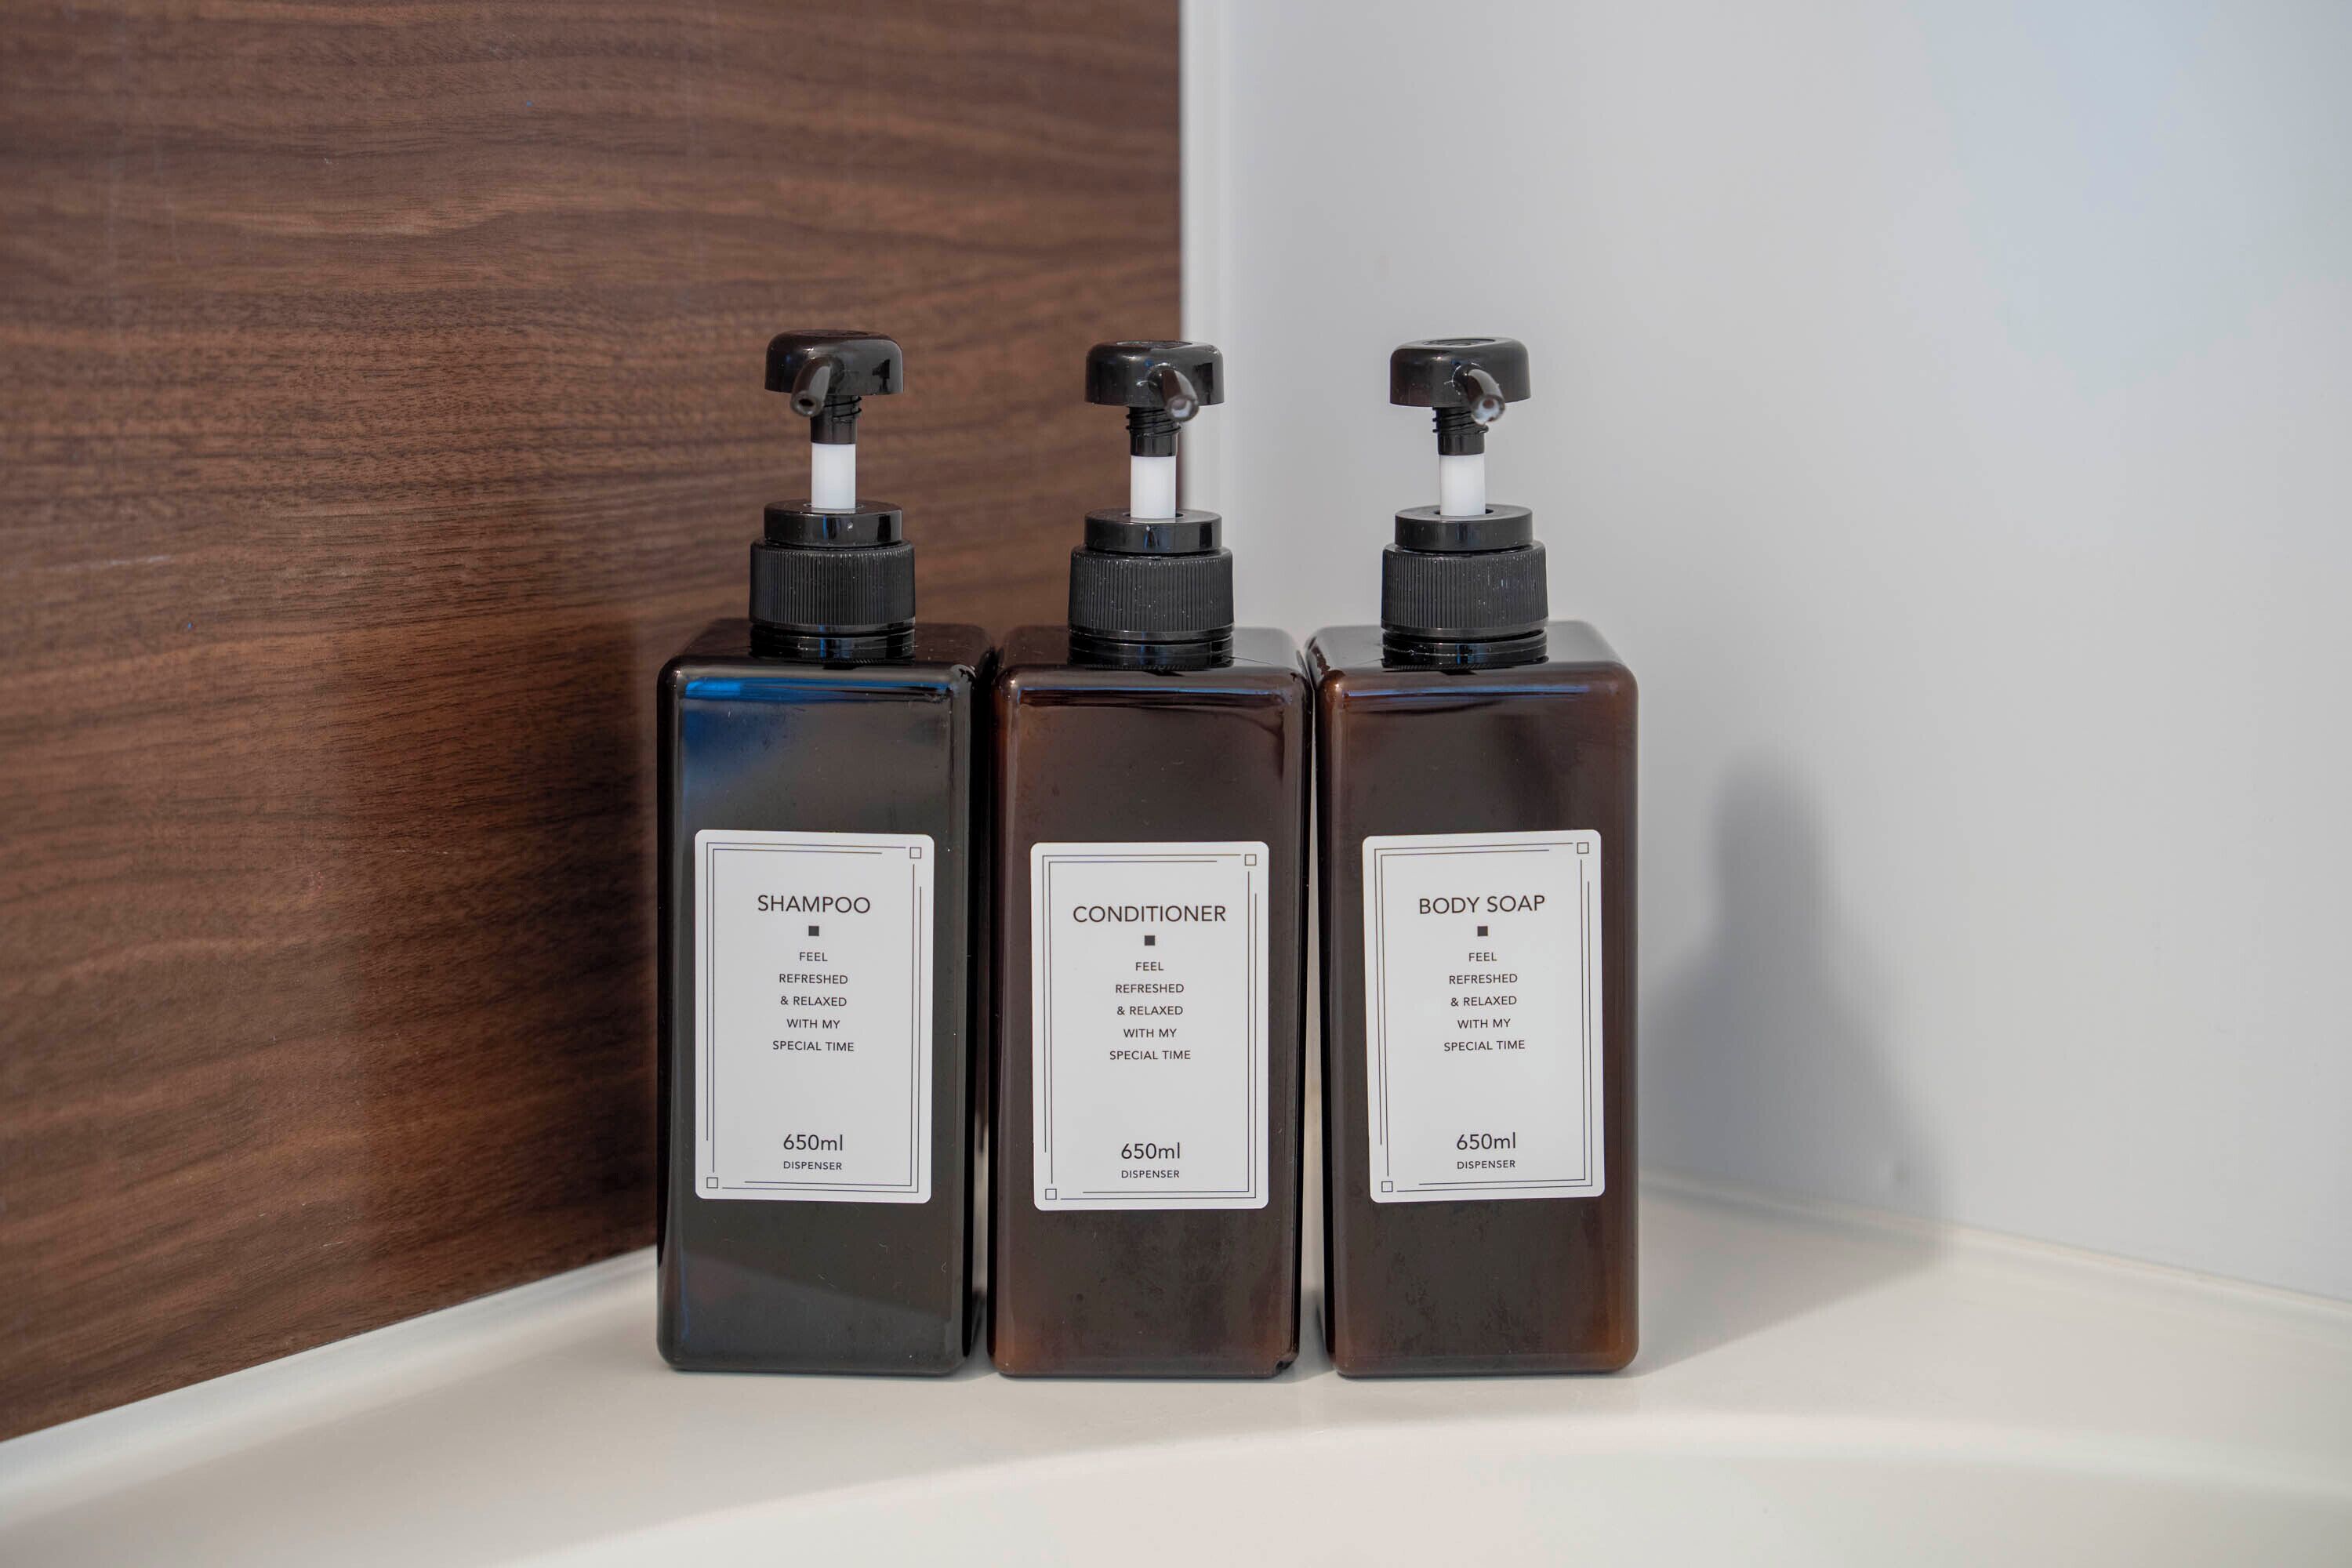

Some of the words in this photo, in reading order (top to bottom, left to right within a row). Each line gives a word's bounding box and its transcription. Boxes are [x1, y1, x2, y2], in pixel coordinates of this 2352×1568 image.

[757, 894, 871, 914] SHAMPOO
[1419, 896, 1480, 915] BODY
[1486, 895, 1545, 913] SOAP
[1073, 905, 1226, 923] CONDITIONER
[799, 951, 829, 962] FEEL
[1468, 952, 1497, 962] FEEL
[1135, 961, 1164, 971] FEEL
[779, 973, 848, 985] REFRESHED
[1449, 973, 1518, 985] REFRESHED
[1115, 983, 1185, 994] REFRESHED
[780, 995, 789, 1007] &
[793, 995, 848, 1007] RELAXED
[1450, 996, 1459, 1007] &
[1463, 995, 1517, 1007] RELAXED
[1116, 1005, 1126, 1016] &
[1129, 1005, 1184, 1016] RELAXED
[786, 1018, 818, 1029] WITH
[822, 1018, 840, 1029] MY
[1457, 1018, 1488, 1029] WITH
[1493, 1018, 1511, 1029] MY
[1123, 1028, 1155, 1038] WITH
[1158, 1028, 1178, 1038] MY
[772, 1040, 822, 1052] SPECIAL
[825, 1040, 855, 1052] TIME
[1443, 1040, 1494, 1052] SPECIAL
[1495, 1040, 1526, 1051] TIME
[1109, 1050, 1159, 1061] SPECIAL
[1161, 1050, 1191, 1061] TIME
[782, 1133, 844, 1152] 650ml
[1456, 1131, 1516, 1151] 650ml
[1120, 1142, 1181, 1160] 650ml
[783, 1160, 843, 1171] DISPENSER
[1457, 1160, 1516, 1170] DISPENSER
[1121, 1170, 1180, 1179] DISPENSER
